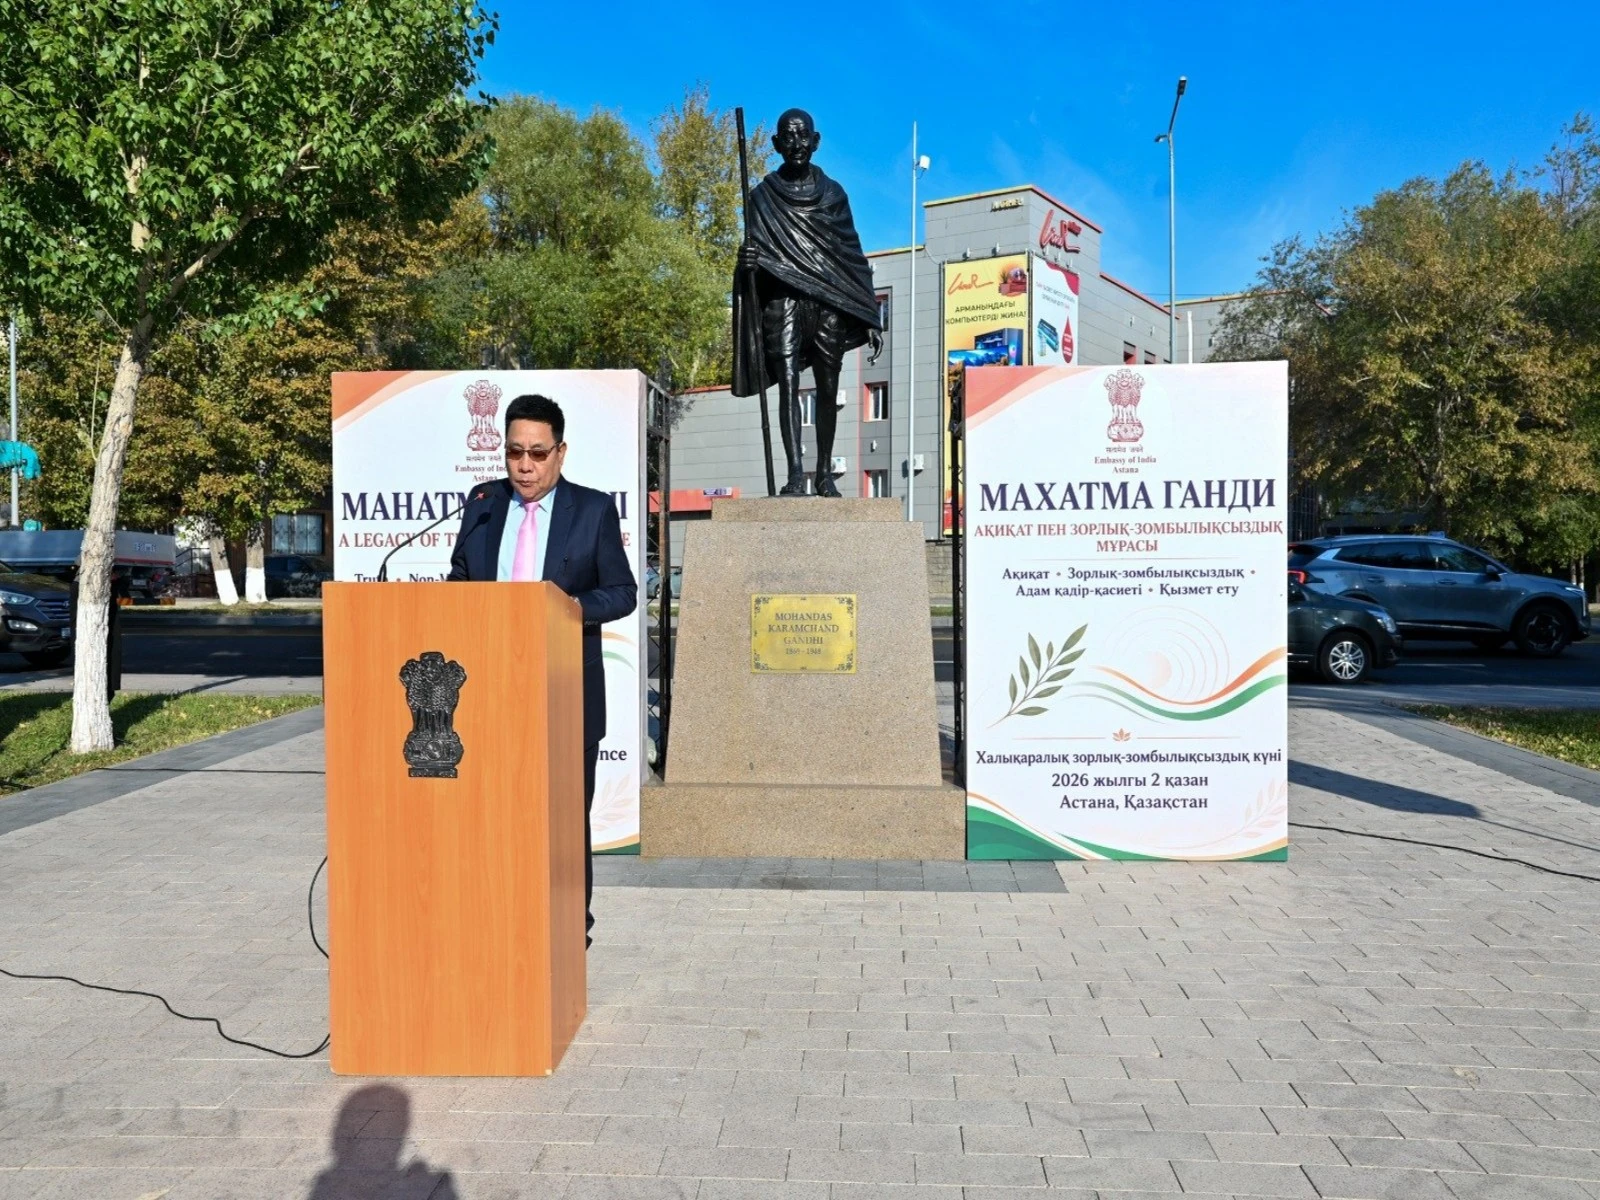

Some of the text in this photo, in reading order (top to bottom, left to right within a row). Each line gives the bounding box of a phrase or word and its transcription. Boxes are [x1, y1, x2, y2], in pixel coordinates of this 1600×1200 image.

[454, 464, 484, 472] Embassy
[486, 464, 494, 472] of
[1094, 456, 1156, 466] Embassy of India
[979, 479, 1275, 513] МАХАТМА ГАНДИ
[341, 492, 469, 520] MAHAT
[975, 521, 1283, 538] АҚИҚАТ ПЕН ЗОРЛЫҚ-ЗОМБЫЛЫҚСЫЗДЫҚ
[339, 533, 349, 547] A
[354, 532, 416, 548] LEGACY
[420, 532, 440, 548] OF
[1097, 540, 1157, 552] МҰРАСЫ
[1003, 567, 1244, 581] Ақиқат Зорлық-зомбылықсыздық
[1016, 584, 1238, 598] Адам қадір-қасиеті Қызмет ету
[775, 612, 832, 622] MOHANDAS
[768, 624, 840, 633] KARAMCHAND
[784, 636, 824, 645] GANDHI
[976, 749, 1281, 766] Халықаралық зорлық-зомбылықсыздық күні
[1052, 773, 1089, 786] 2026
[1151, 773, 1160, 786] 2
[1165, 777, 1208, 788] қазан
[1060, 795, 1207, 810] Астана, Қазақстан
